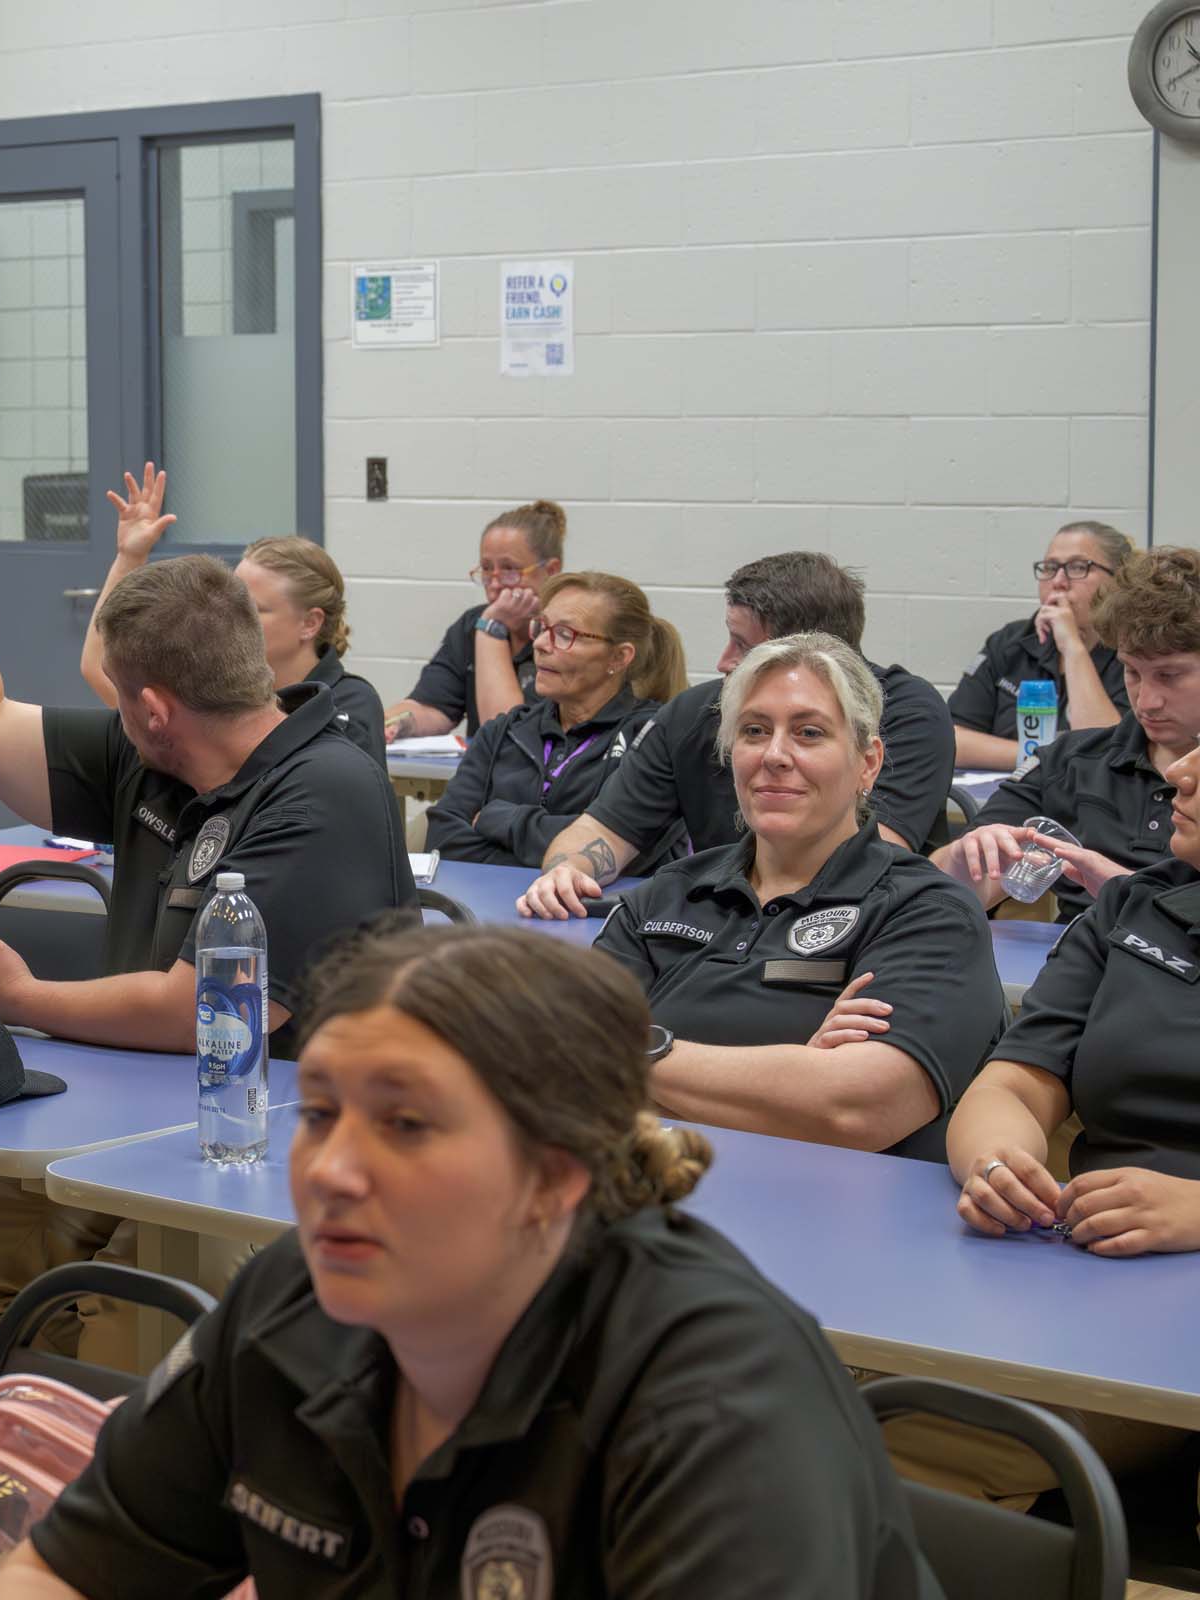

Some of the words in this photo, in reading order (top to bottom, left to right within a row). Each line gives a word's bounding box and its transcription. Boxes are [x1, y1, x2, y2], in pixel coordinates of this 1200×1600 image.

[505, 275, 535, 289] REFER
[538, 274, 544, 289] A
[505, 305, 530, 320] EARN
[801, 909, 852, 925] MISSOURI
[643, 920, 714, 943] CULBERTSON
[1123, 934, 1194, 973] PAZ
[230, 1482, 345, 1558] SEIFERT
